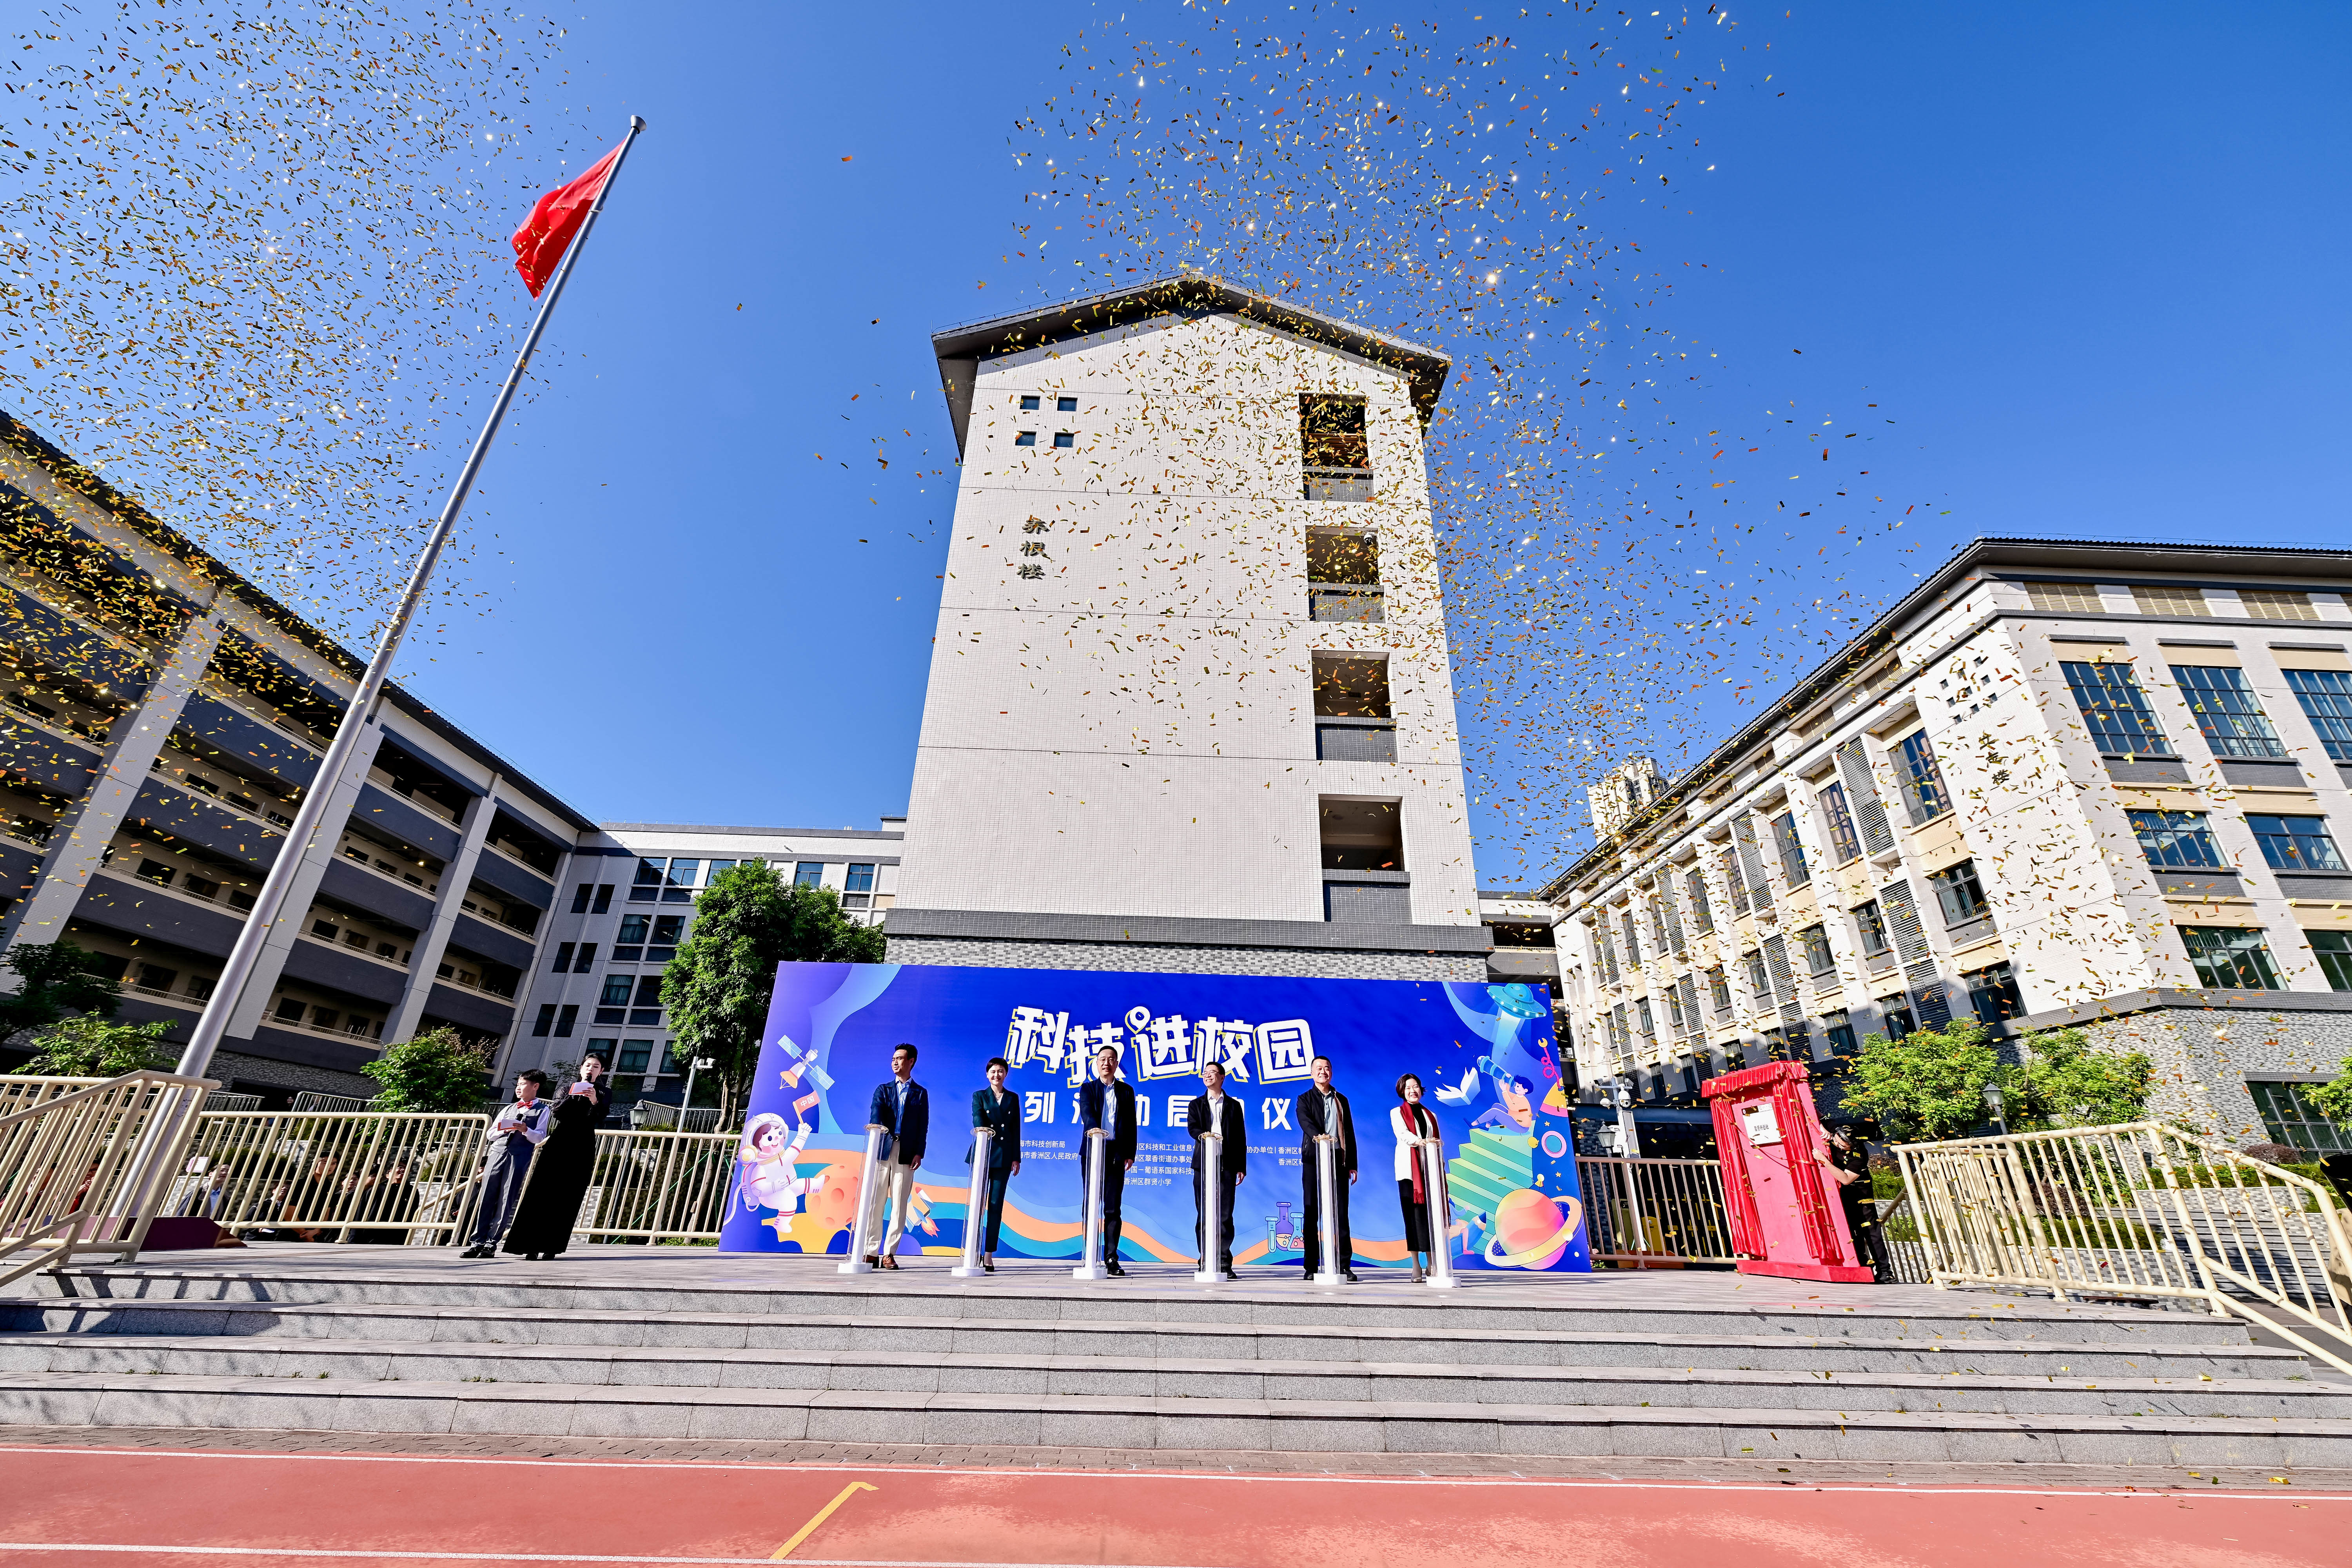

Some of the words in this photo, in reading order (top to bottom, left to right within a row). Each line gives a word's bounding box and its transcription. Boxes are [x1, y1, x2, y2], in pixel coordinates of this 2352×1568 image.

[1005, 1006, 1315, 1087] 科技进校园
[800, 1095, 815, 1107] 中国
[1137, 1143, 1195, 1152] 区科技和工业信息
[1124, 1177, 1172, 1186] 香洲区群贤小学
